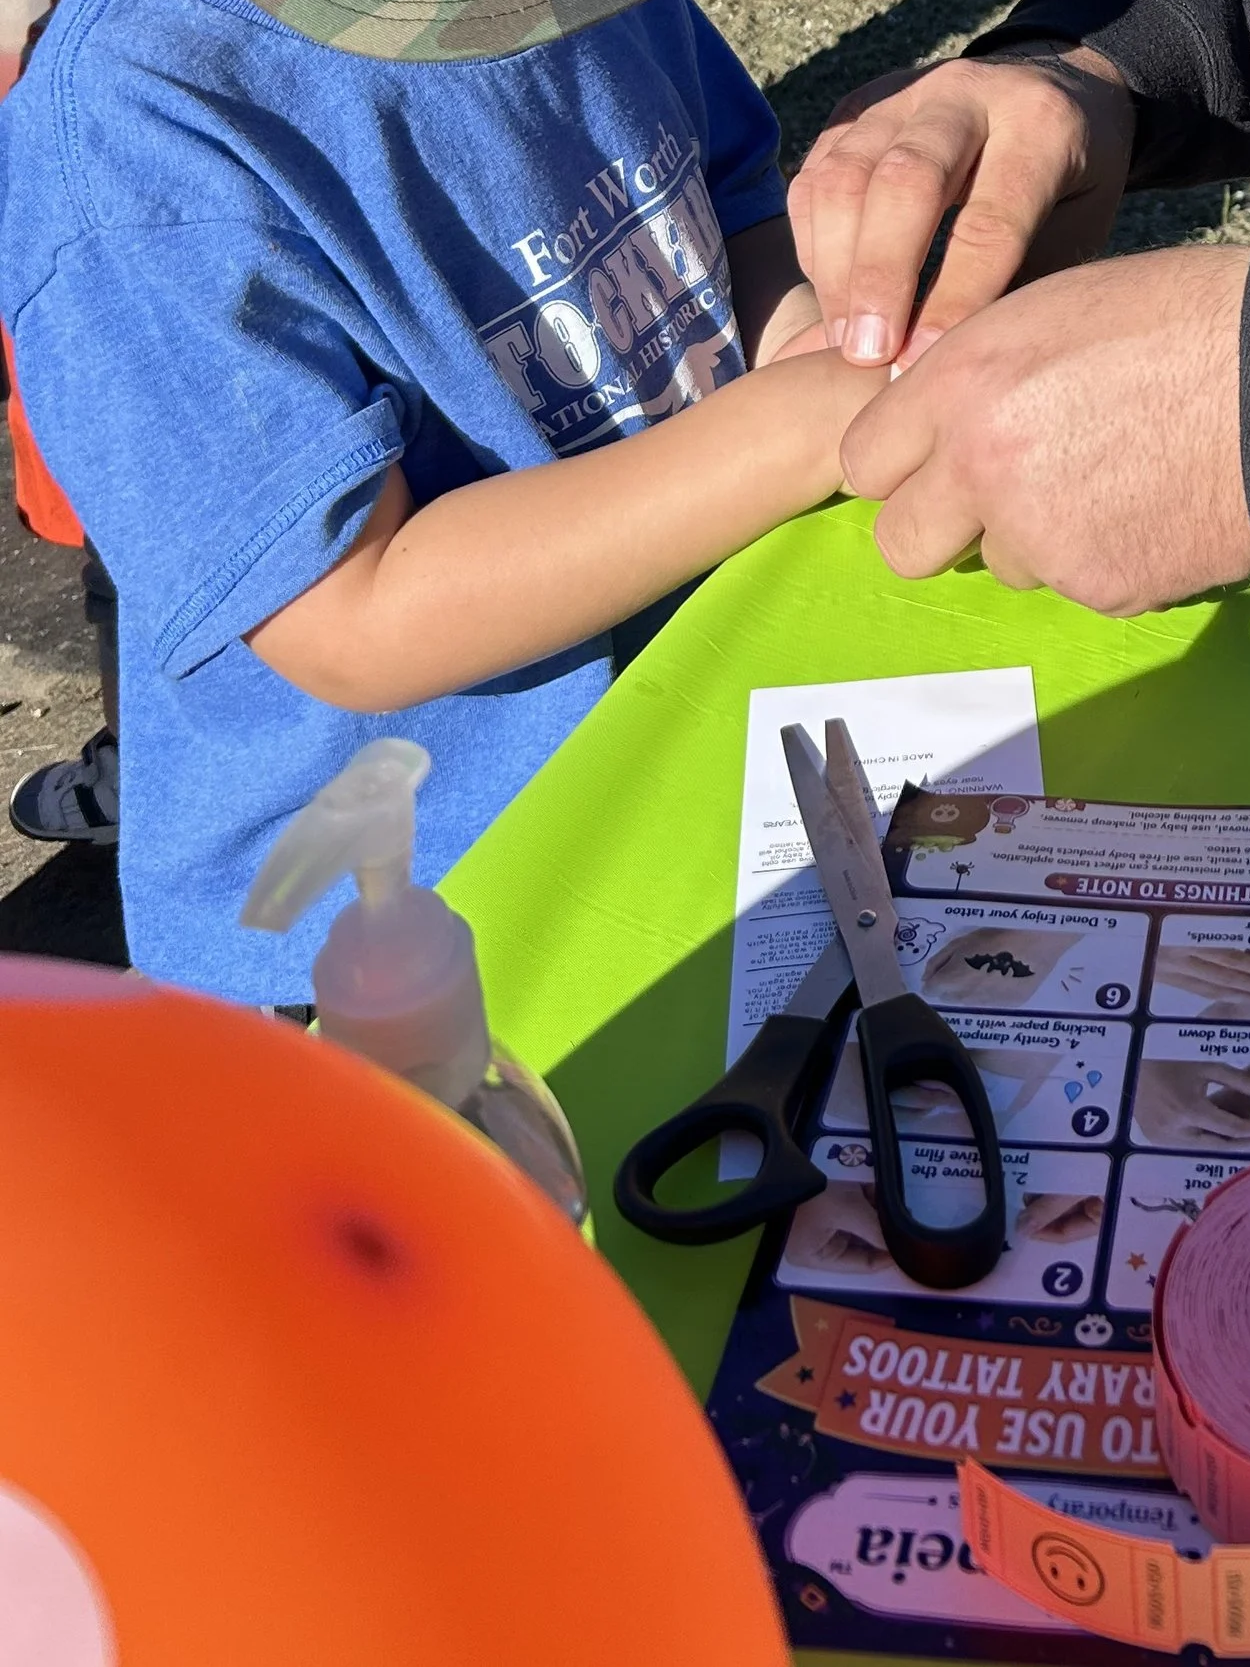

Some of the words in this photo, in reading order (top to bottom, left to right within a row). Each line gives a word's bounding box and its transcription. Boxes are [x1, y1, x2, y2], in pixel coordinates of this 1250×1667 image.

[511, 206, 599, 288] Fort
[585, 121, 682, 219] Worth
[539, 360, 643, 438] ATIONAL
[638, 287, 717, 371] HISTORIC
[902, 753, 933, 761] MADE
[1174, 811, 1216, 822] rubbing
[763, 820, 798, 828] YEARS
[1091, 818, 1135, 829] makeup
[1160, 821, 1187, 831] baby
[1017, 844, 1053, 853] before
[1057, 847, 1105, 858] products
[1109, 850, 1136, 861] body
[1183, 855, 1203, 863] use
[1056, 857, 1090, 868] tattoo
[1094, 861, 1125, 871] affect
[1152, 863, 1220, 875] moisturizers
[1224, 867, 1245, 876] and
[1076, 877, 1132, 895] NOTE
[1139, 882, 1166, 898] TO
[944, 906, 984, 917] tattoo
[988, 907, 1017, 919] your
[1021, 909, 1056, 924] Enjoy
[1061, 915, 1098, 927] Done!
[1103, 917, 1117, 928] 6.
[1187, 930, 1244, 943] seconds,
[1105, 987, 1121, 1005] 6
[977, 1019, 1006, 1030] with
[1010, 1019, 1049, 1031] paper
[1053, 1021, 1106, 1036] backing
[1013, 1033, 1060, 1048] Gently
[1179, 1029, 1215, 1041] down
[1066, 1038, 1080, 1049] 4.
[1200, 1044, 1228, 1056] skin
[1232, 1045, 1249, 1055] on
[1083, 1111, 1100, 1131] 4
[914, 1148, 945, 1163] film
[911, 1165, 937, 1179] the
[1195, 1163, 1226, 1178] like
[1054, 1267, 1071, 1292] 2
[842, 1335, 1024, 1399] TATTOOS
[1036, 1360, 1156, 1407] RARY
[859, 1389, 981, 1451] YOUR
[996, 1407, 1086, 1460] USE
[1102, 1416, 1159, 1463] TO
[1048, 1494, 1176, 1530] Temporary
